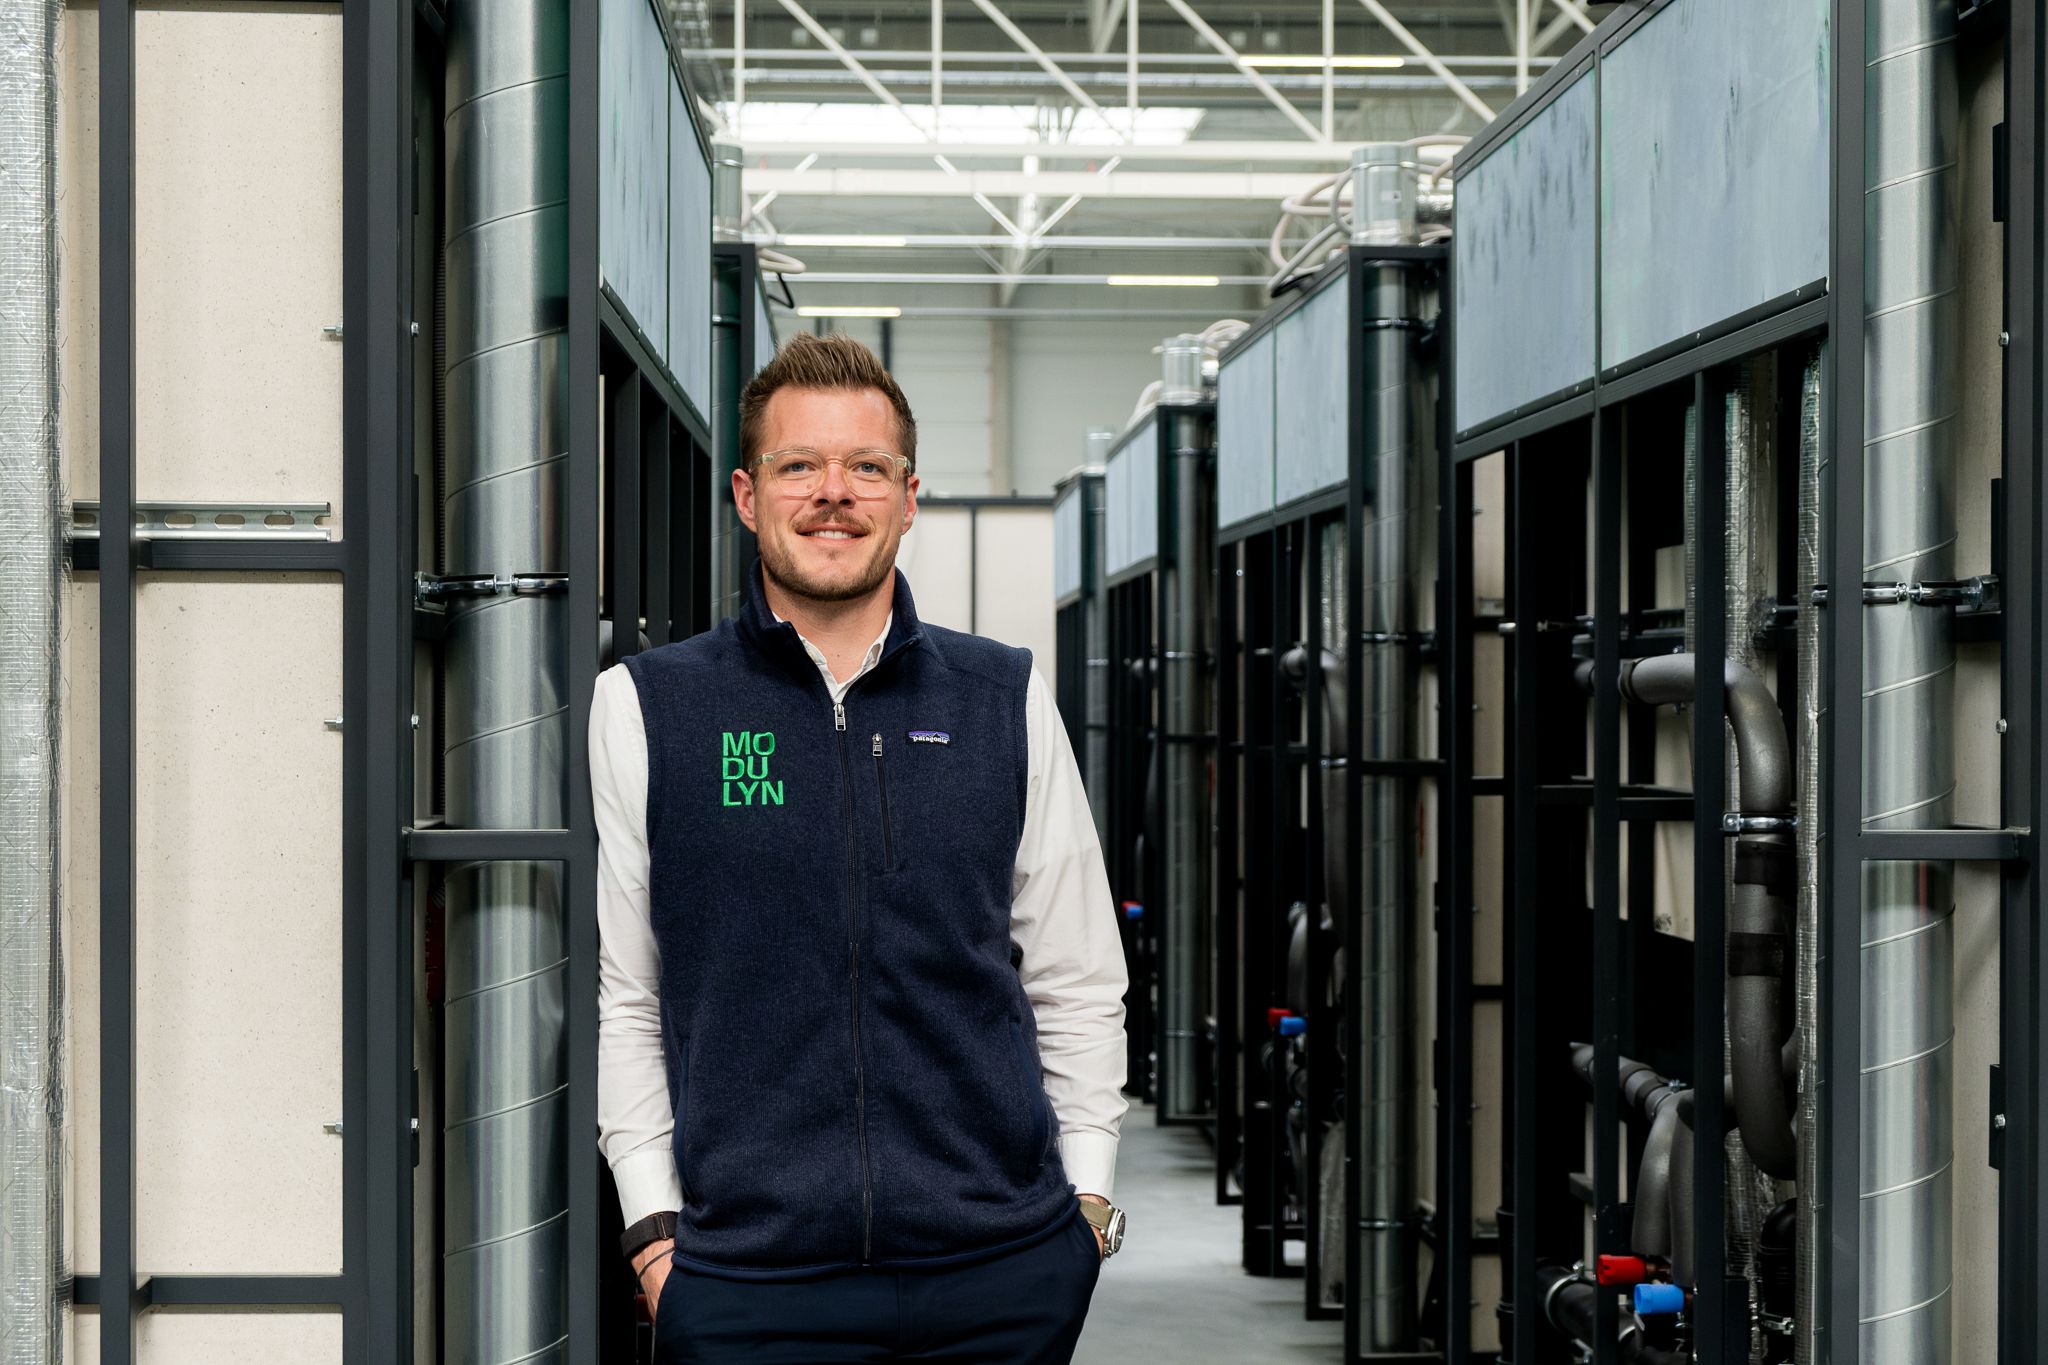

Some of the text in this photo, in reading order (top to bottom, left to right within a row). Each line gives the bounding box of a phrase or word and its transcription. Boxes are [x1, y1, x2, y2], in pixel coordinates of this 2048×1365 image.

[722, 731, 776, 756] MO
[912, 736, 948, 744] patagonia
[722, 756, 768, 780] DU
[723, 780, 784, 806] LYN
